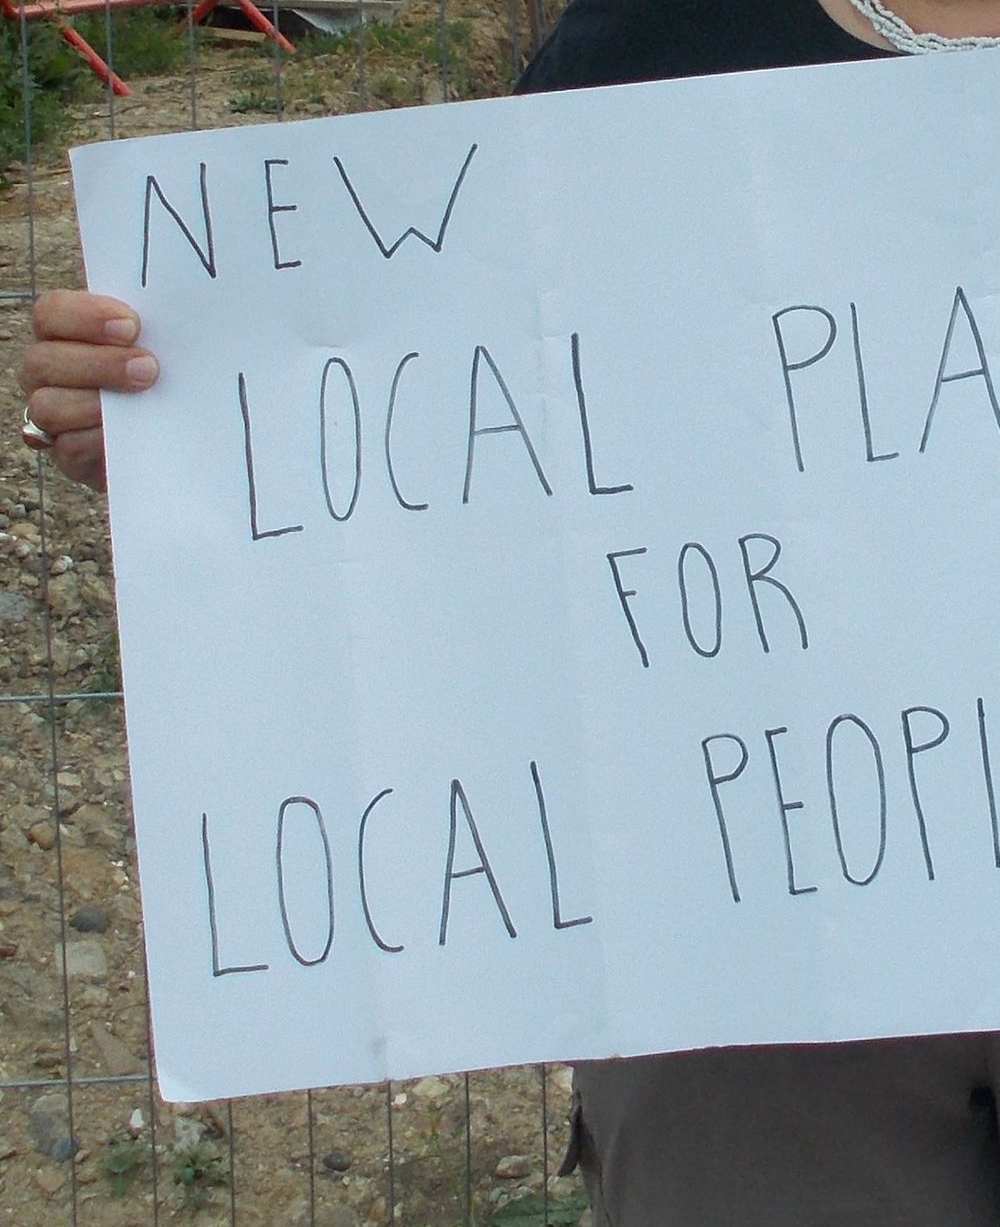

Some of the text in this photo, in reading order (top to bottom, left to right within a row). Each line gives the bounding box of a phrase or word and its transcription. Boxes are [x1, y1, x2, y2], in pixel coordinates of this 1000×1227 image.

[142, 143, 478, 288] NEW
[238, 332, 635, 541] LOCAL
[607, 533, 809, 668] FOR
[202, 760, 593, 976] LOCAL
